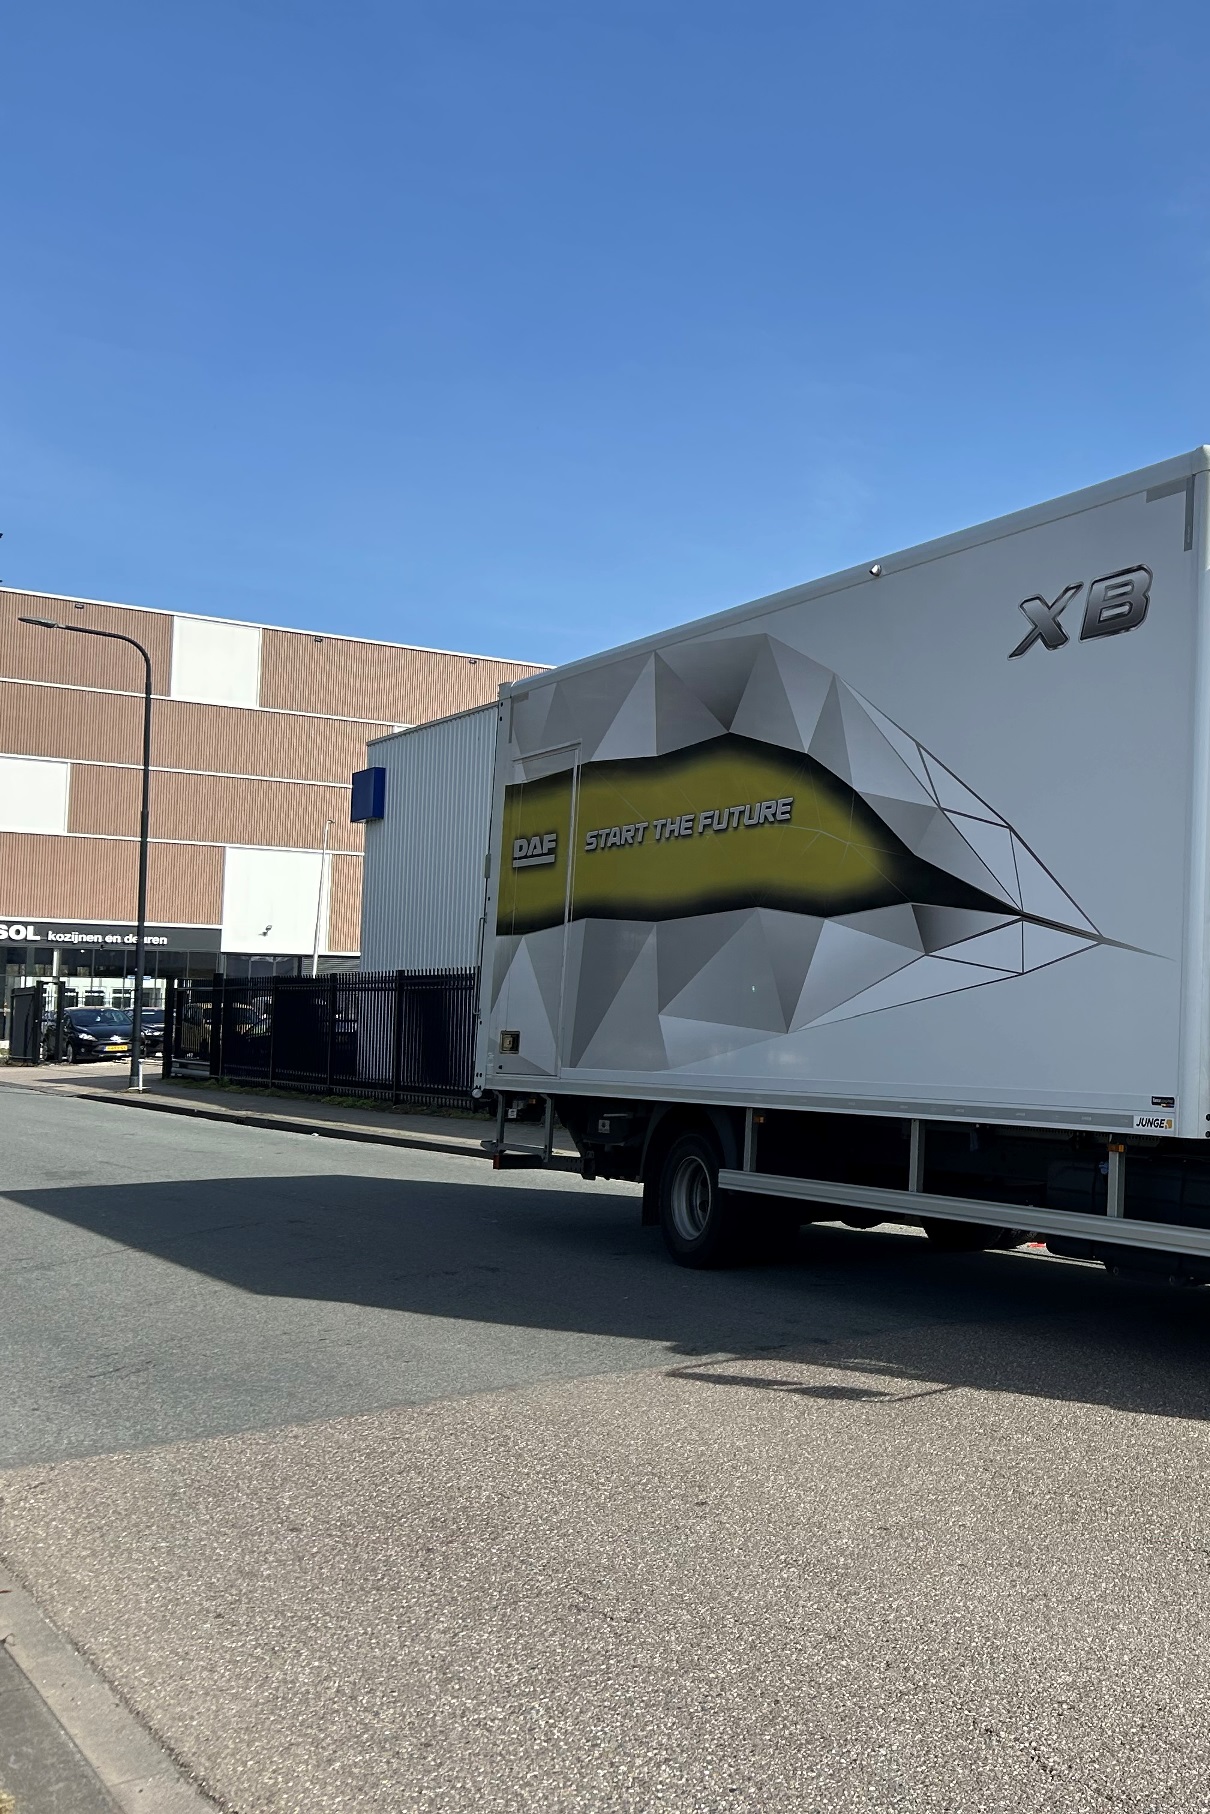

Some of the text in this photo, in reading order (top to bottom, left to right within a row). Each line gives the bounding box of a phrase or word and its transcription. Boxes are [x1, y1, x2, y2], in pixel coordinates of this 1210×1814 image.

[1007, 563, 1154, 661] XB
[584, 797, 794, 851] START THE FUTURE
[512, 832, 557, 858] DAF
[47, 930, 102, 944] kozijnen
[105, 933, 122, 944] en
[1136, 1116, 1166, 1129] JUNGE
